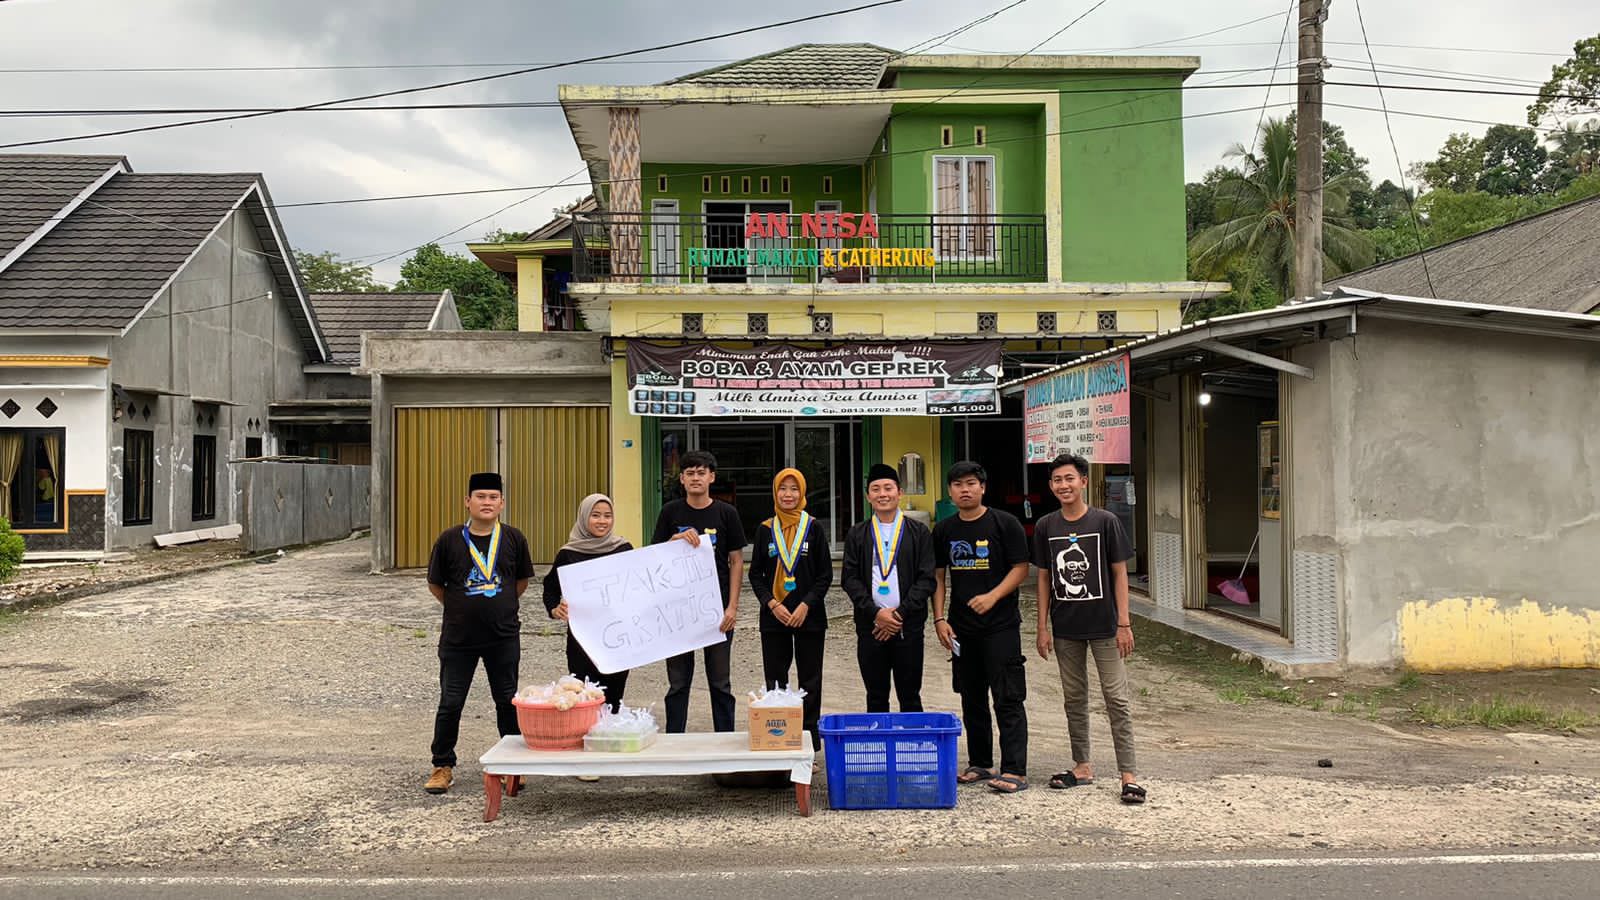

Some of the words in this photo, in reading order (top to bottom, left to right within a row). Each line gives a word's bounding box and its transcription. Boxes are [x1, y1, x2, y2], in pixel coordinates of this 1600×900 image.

[745, 212, 789, 239] AN
[801, 212, 879, 239] NISA
[688, 248, 748, 267] RUMAH
[757, 248, 819, 267] MAKAN
[823, 248, 836, 267] &
[838, 247, 936, 267] CATHERING
[696, 349, 756, 360] Minuman
[760, 351, 791, 360] Enak
[682, 360, 749, 377] BOBA
[754, 361, 774, 377] &
[778, 361, 843, 377] AYAM
[849, 360, 946, 377] GEPREK
[1087, 360, 1127, 397] ANNISA
[710, 391, 753, 402] Milk
[757, 391, 819, 402] Annisa
[822, 391, 854, 402] Tea
[859, 391, 919, 401] Annisa
[929, 404, 994, 413] Rp.15.000
[602, 590, 720, 649] GRATIS
